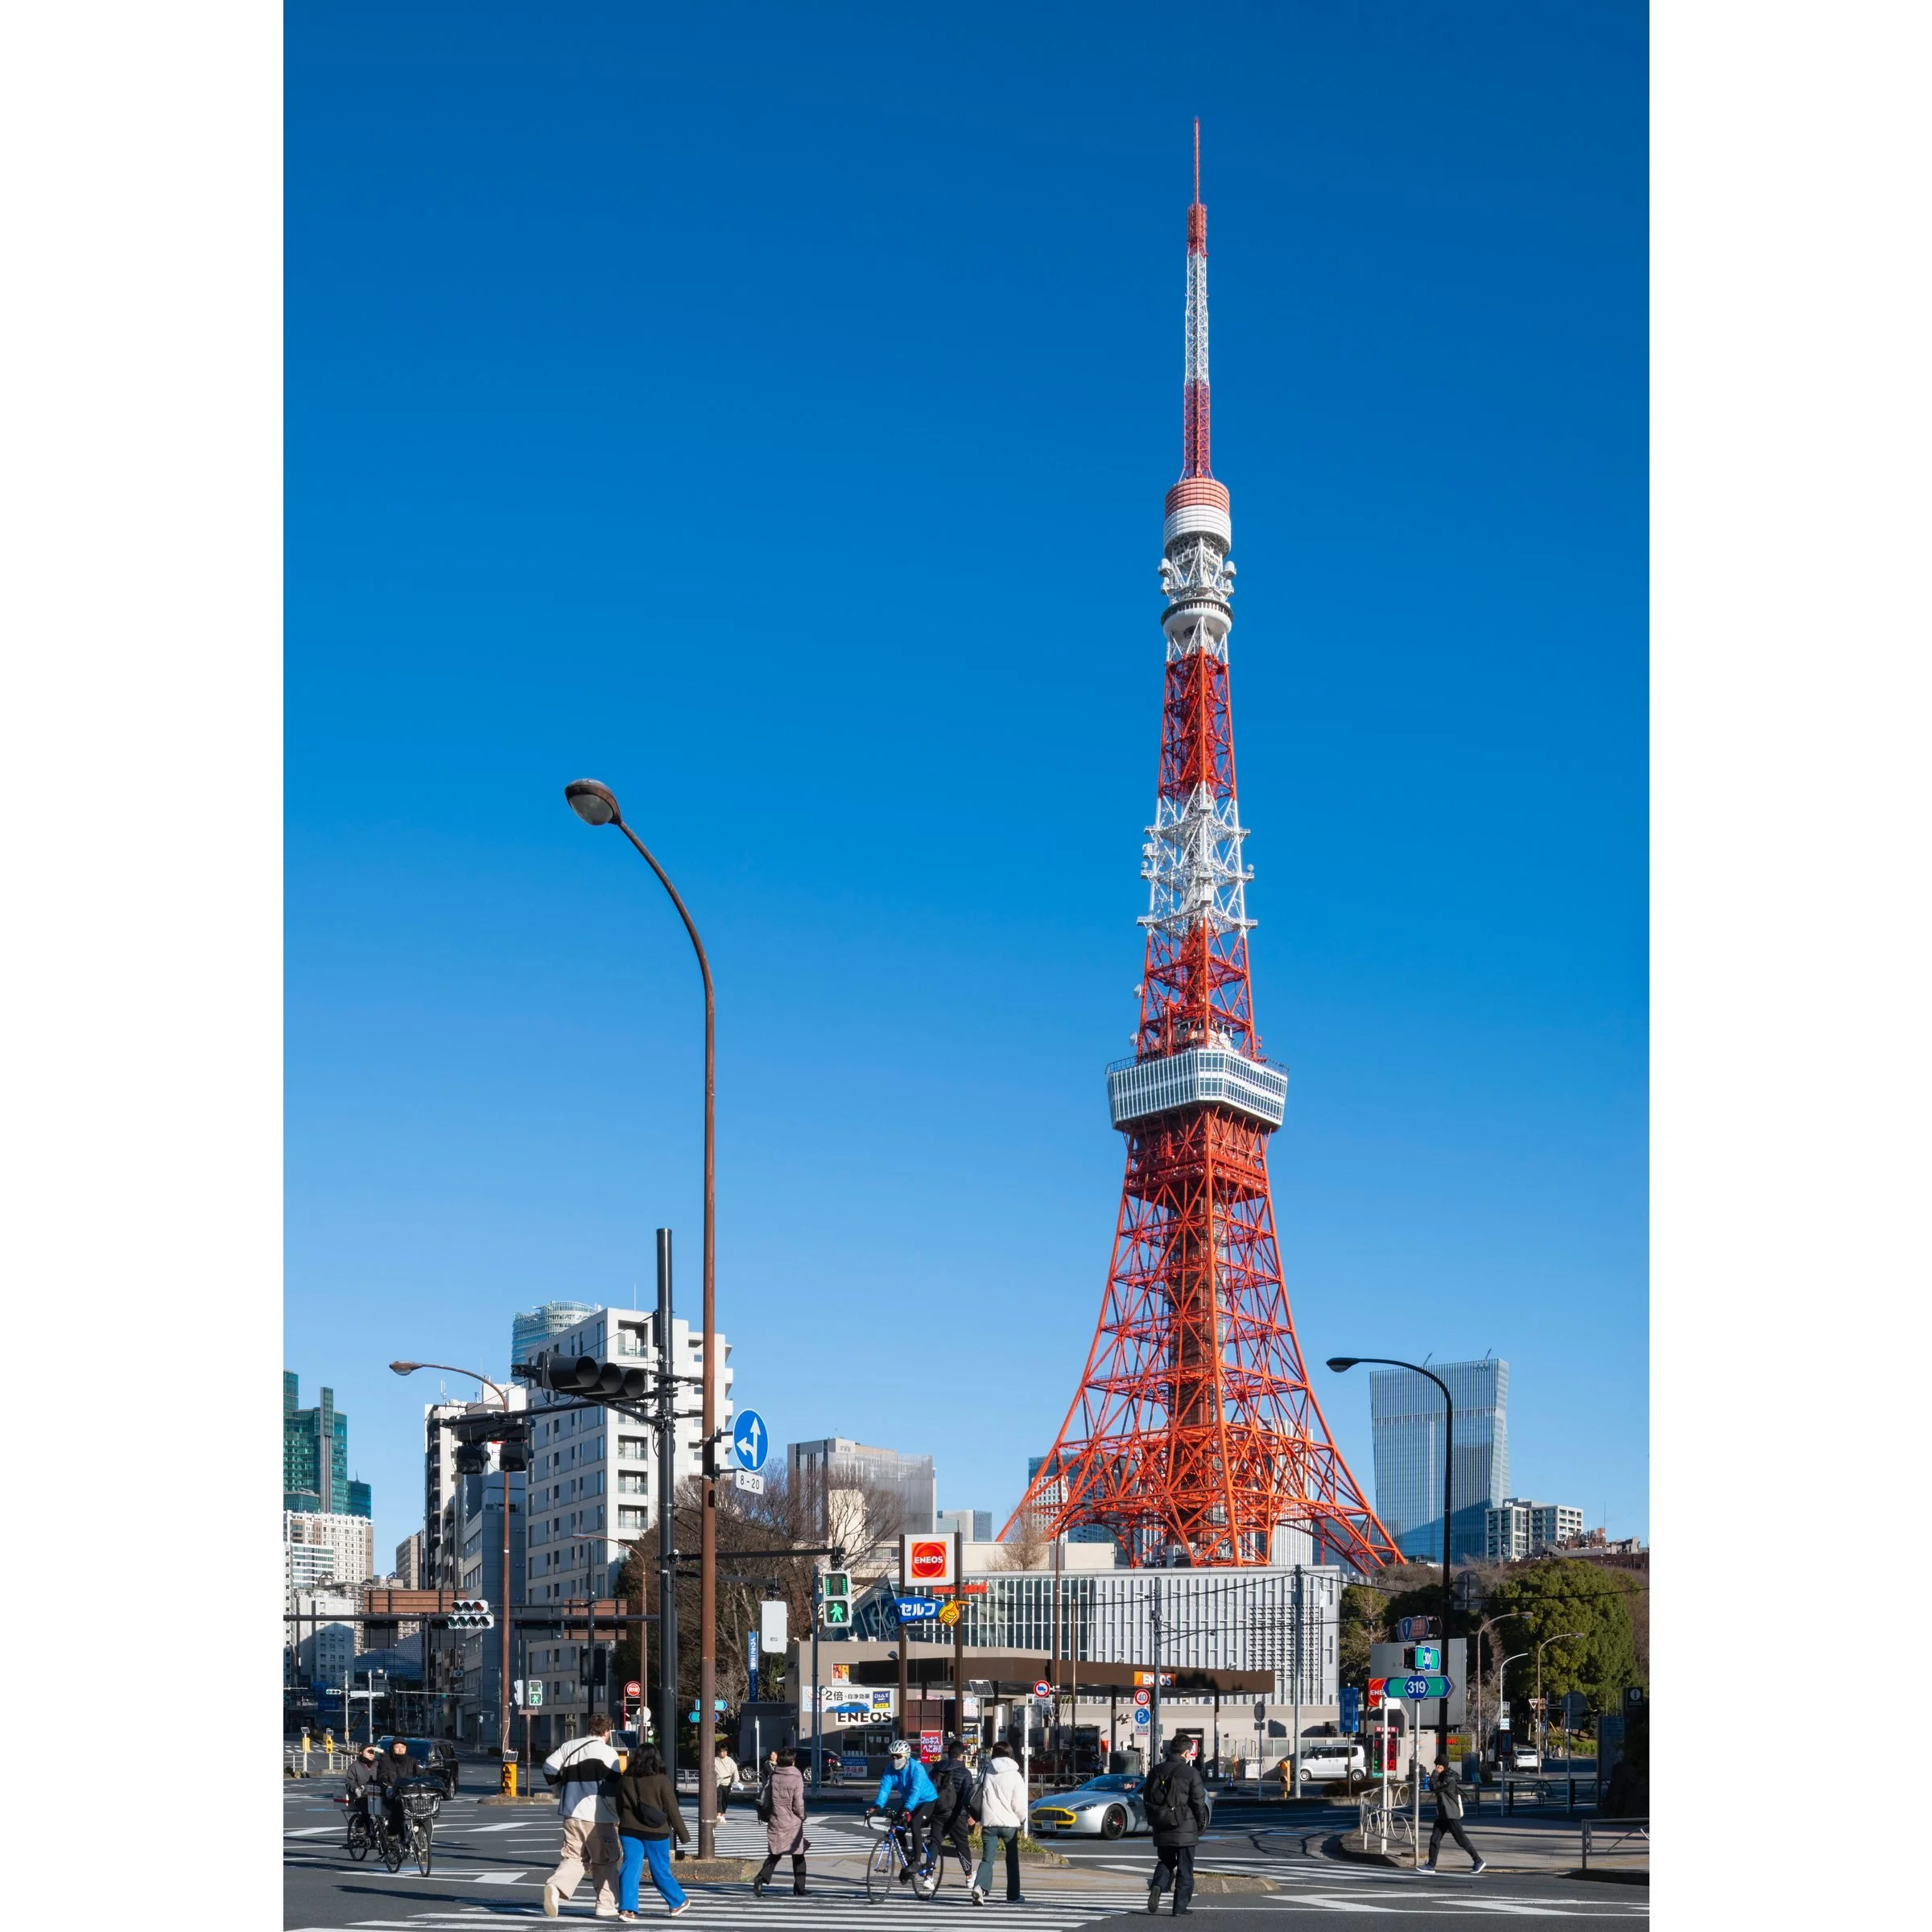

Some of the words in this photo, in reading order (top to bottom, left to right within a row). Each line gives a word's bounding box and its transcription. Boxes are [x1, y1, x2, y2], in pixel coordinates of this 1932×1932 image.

[740, 1475, 760, 1490] 8-20
[914, 1555, 943, 1564] ENEOS
[900, 1603, 936, 1616] セルフ
[1143, 1674, 1172, 1686] ENOS
[1407, 1681, 1426, 1694] 319
[837, 1712, 892, 1723] ENEOS
[1137, 1711, 1144, 1722] P
